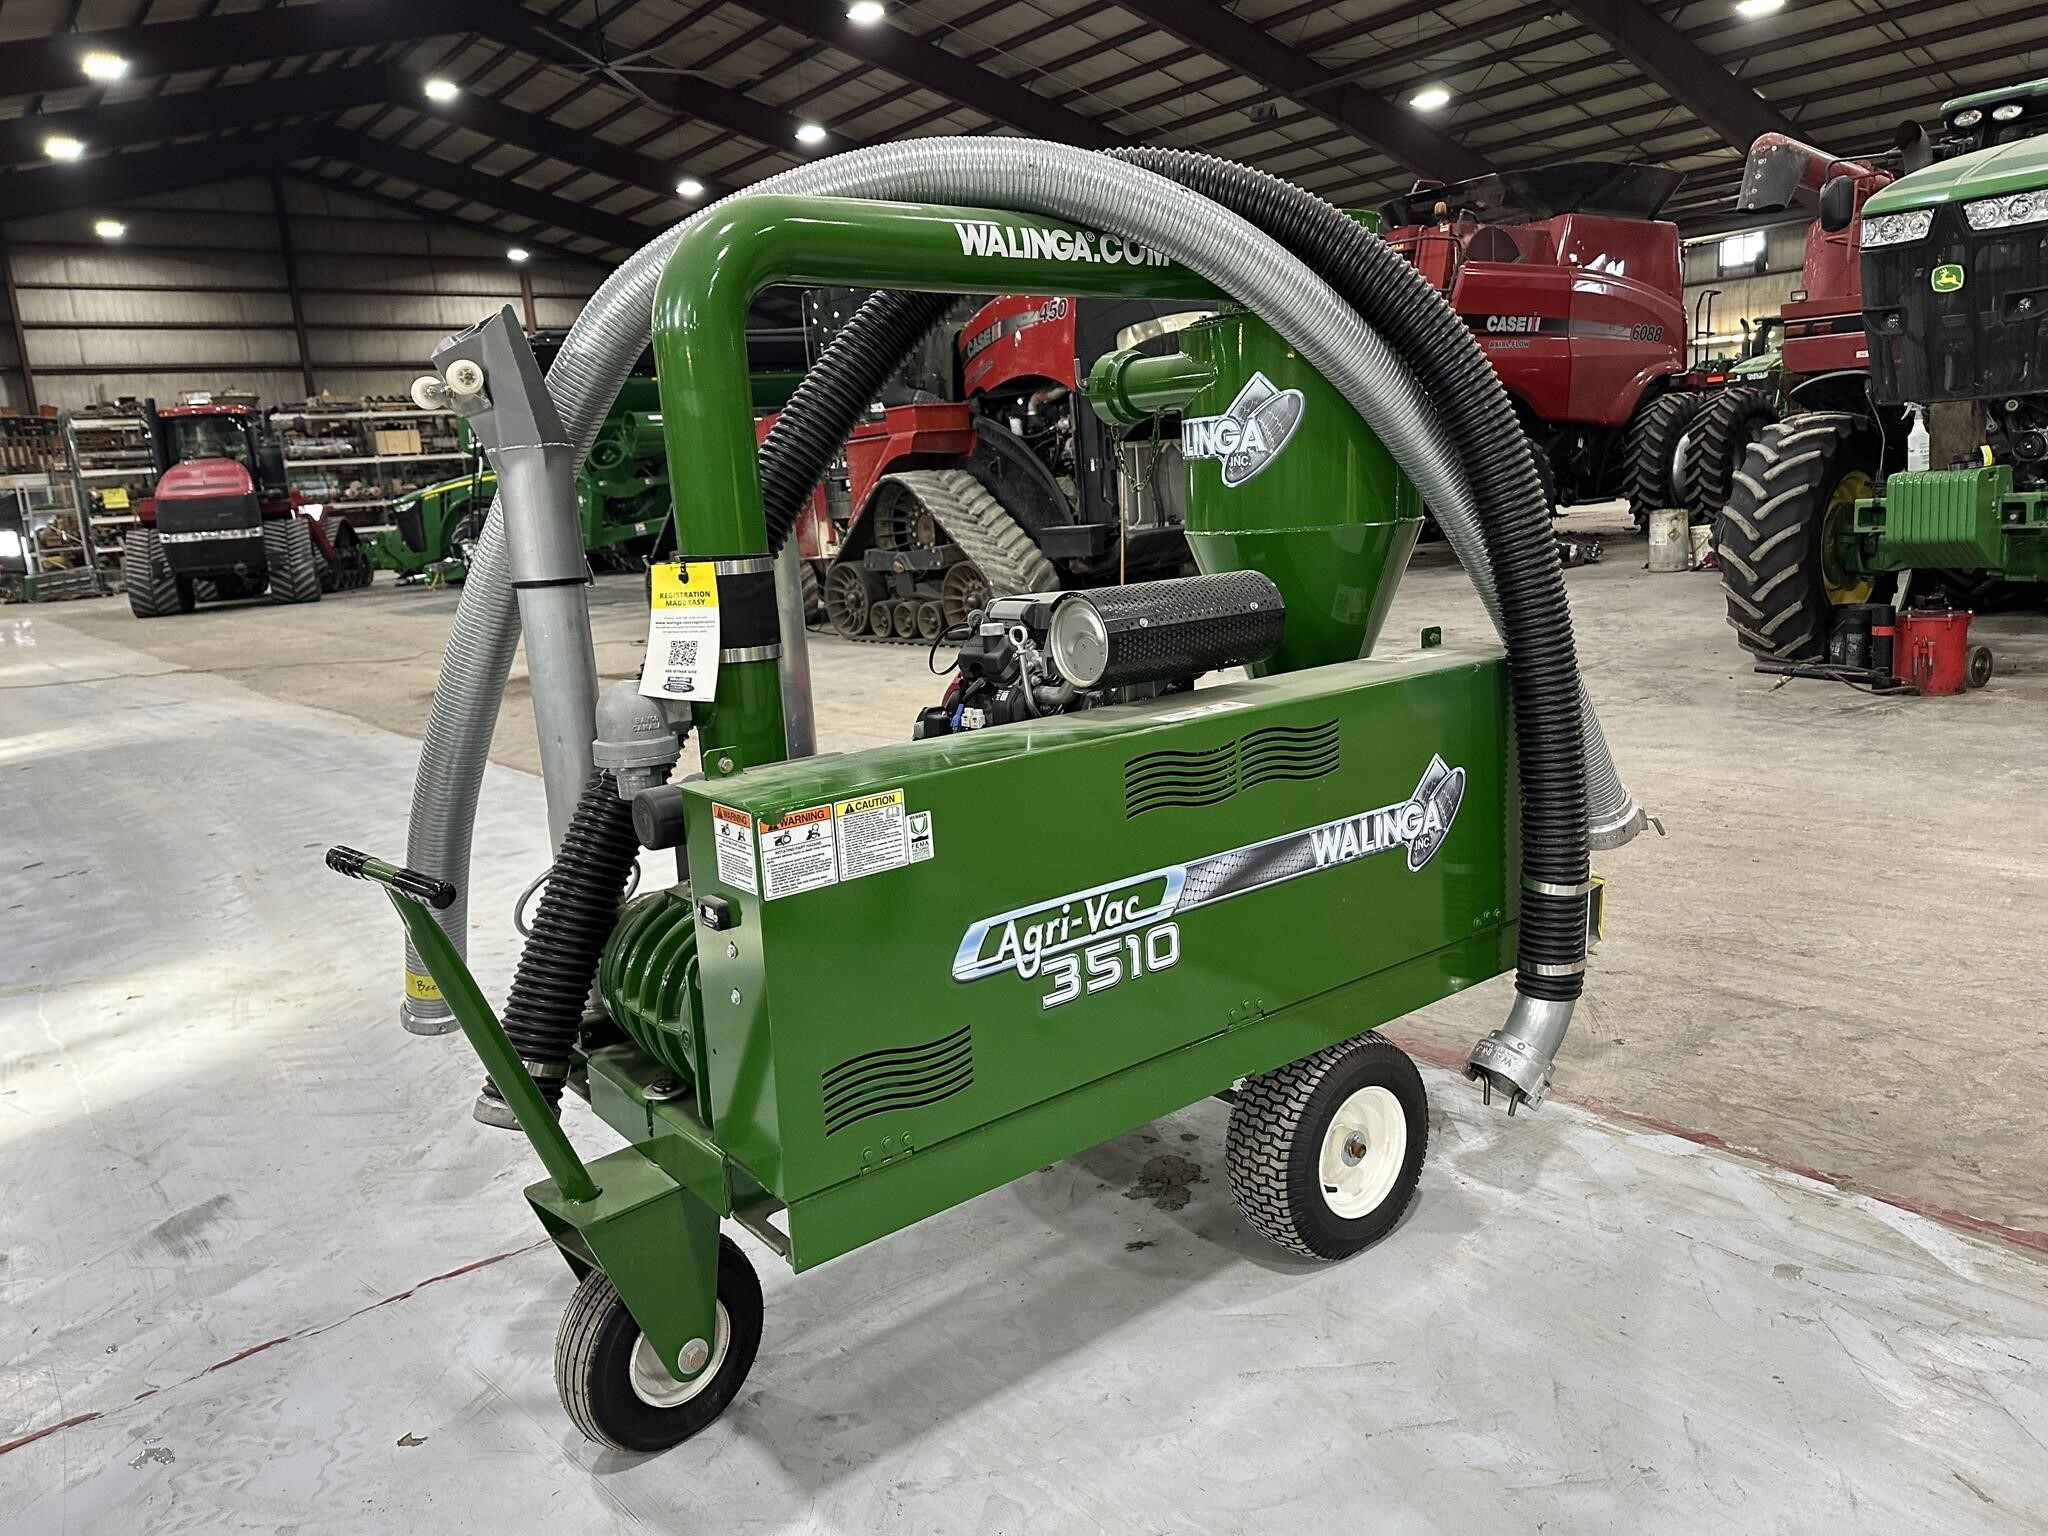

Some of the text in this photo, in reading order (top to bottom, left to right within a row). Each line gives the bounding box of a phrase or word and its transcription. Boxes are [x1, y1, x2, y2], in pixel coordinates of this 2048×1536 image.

[1040, 298, 1068, 323] 450
[1631, 324, 1663, 343] 6088
[1230, 455, 1252, 467] INC.
[659, 591, 711, 599] REGISTRATION
[688, 598, 706, 606] EASY
[855, 794, 896, 812] CAUTION
[722, 807, 748, 825] WARNING
[780, 809, 825, 828] WARNING
[1310, 798, 1443, 868] WALINGA
[1414, 834, 1432, 850] INC.
[911, 840, 930, 849] FEMA
[998, 892, 1141, 979] Agri-Vac
[1041, 921, 1181, 1010] 3510
